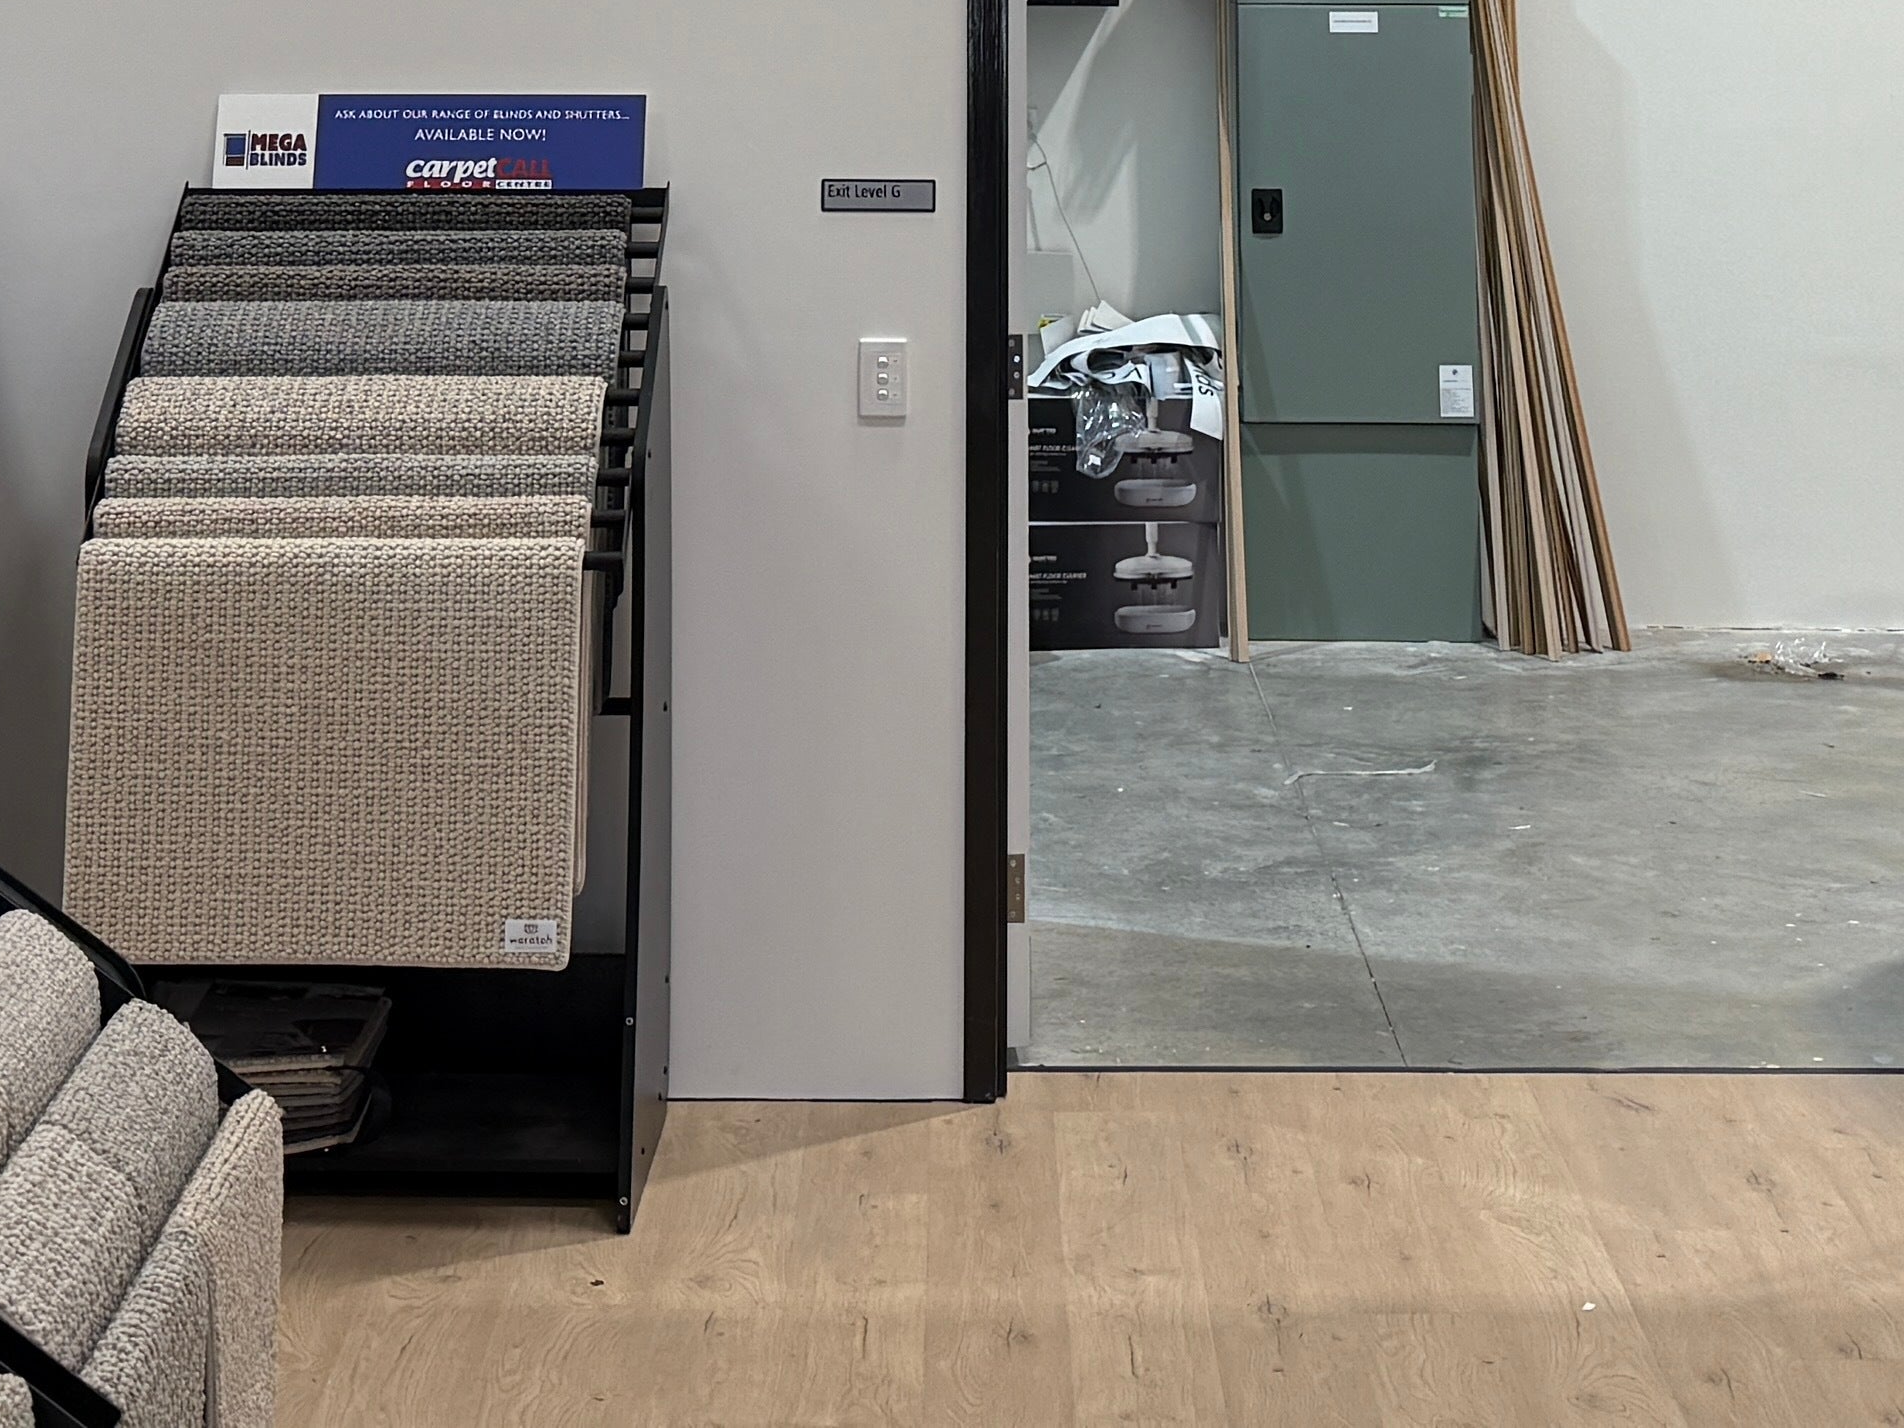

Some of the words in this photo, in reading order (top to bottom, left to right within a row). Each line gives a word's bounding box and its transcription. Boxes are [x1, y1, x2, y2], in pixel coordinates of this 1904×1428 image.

[335, 109, 356, 120] ASK
[358, 109, 398, 120] ABOUT
[402, 109, 428, 120] OUR
[431, 109, 471, 120] RANGE
[474, 109, 488, 120] OF
[493, 109, 533, 120] BLINDS
[535, 109, 561, 120] AND
[250, 133, 307, 152] MEGA
[414, 128, 495, 141] AVAILABLE
[499, 128, 547, 142] NOW!
[249, 152, 307, 167] BLINDS
[827, 183, 851, 199] Exit
[854, 183, 888, 199] Level
[890, 183, 902, 199] G
